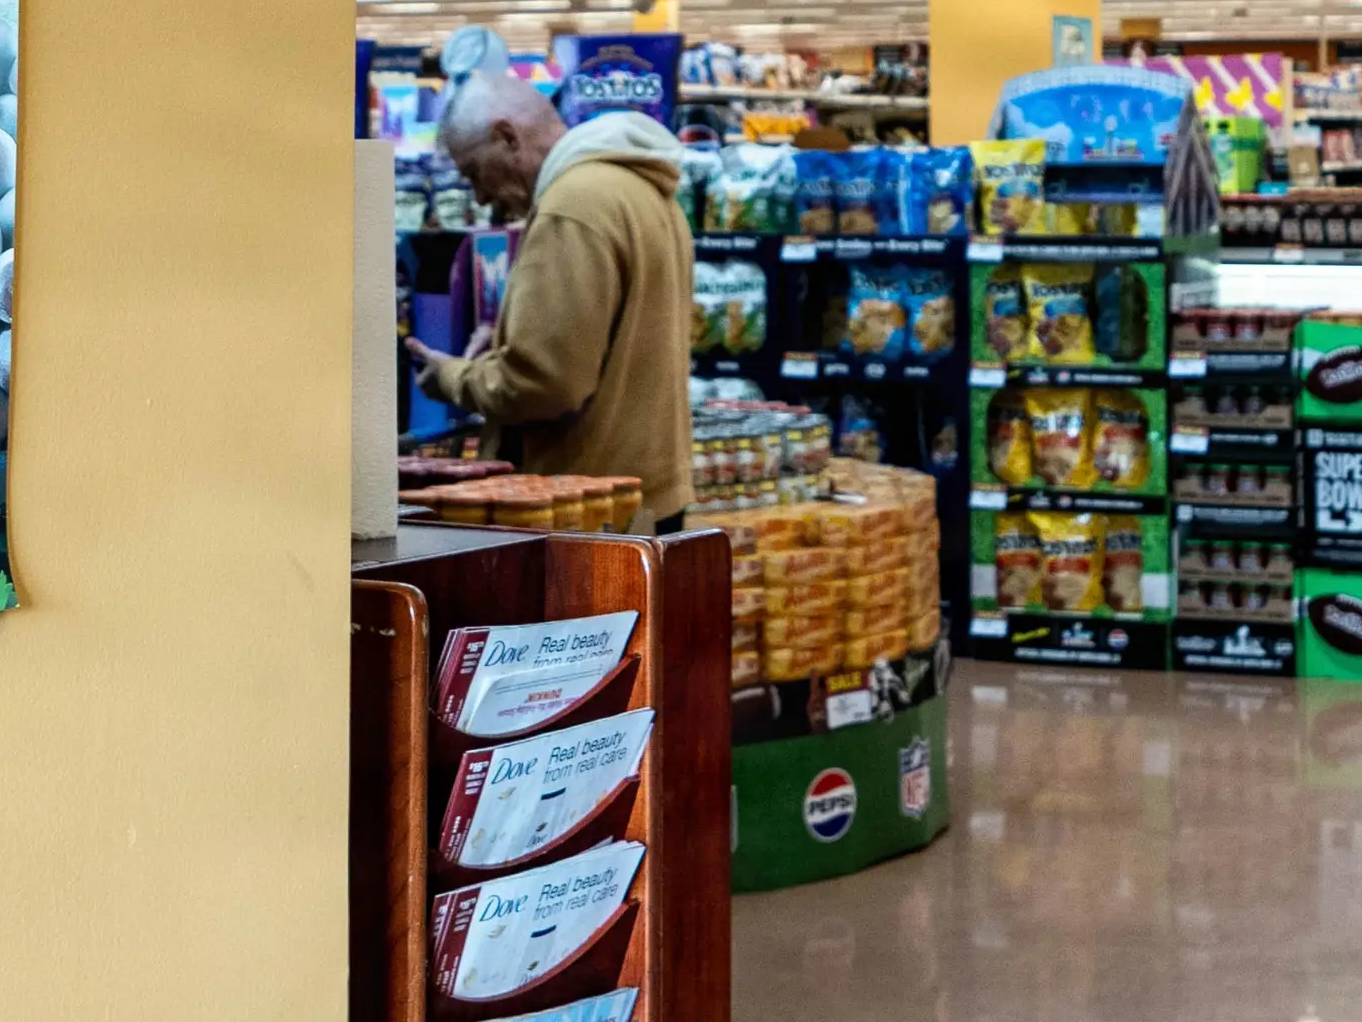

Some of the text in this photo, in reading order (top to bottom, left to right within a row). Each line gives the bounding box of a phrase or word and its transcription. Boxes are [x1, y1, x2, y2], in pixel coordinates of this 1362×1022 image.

[484, 630, 614, 668] Dove Real beauty
[491, 757, 539, 786] Dove
[548, 741, 580, 766] Real
[581, 731, 627, 758] beauty
[542, 746, 627, 785] from real care
[807, 793, 853, 816] PEPSI
[479, 867, 618, 923] Dove Real beauty
[533, 882, 619, 922] from real care
